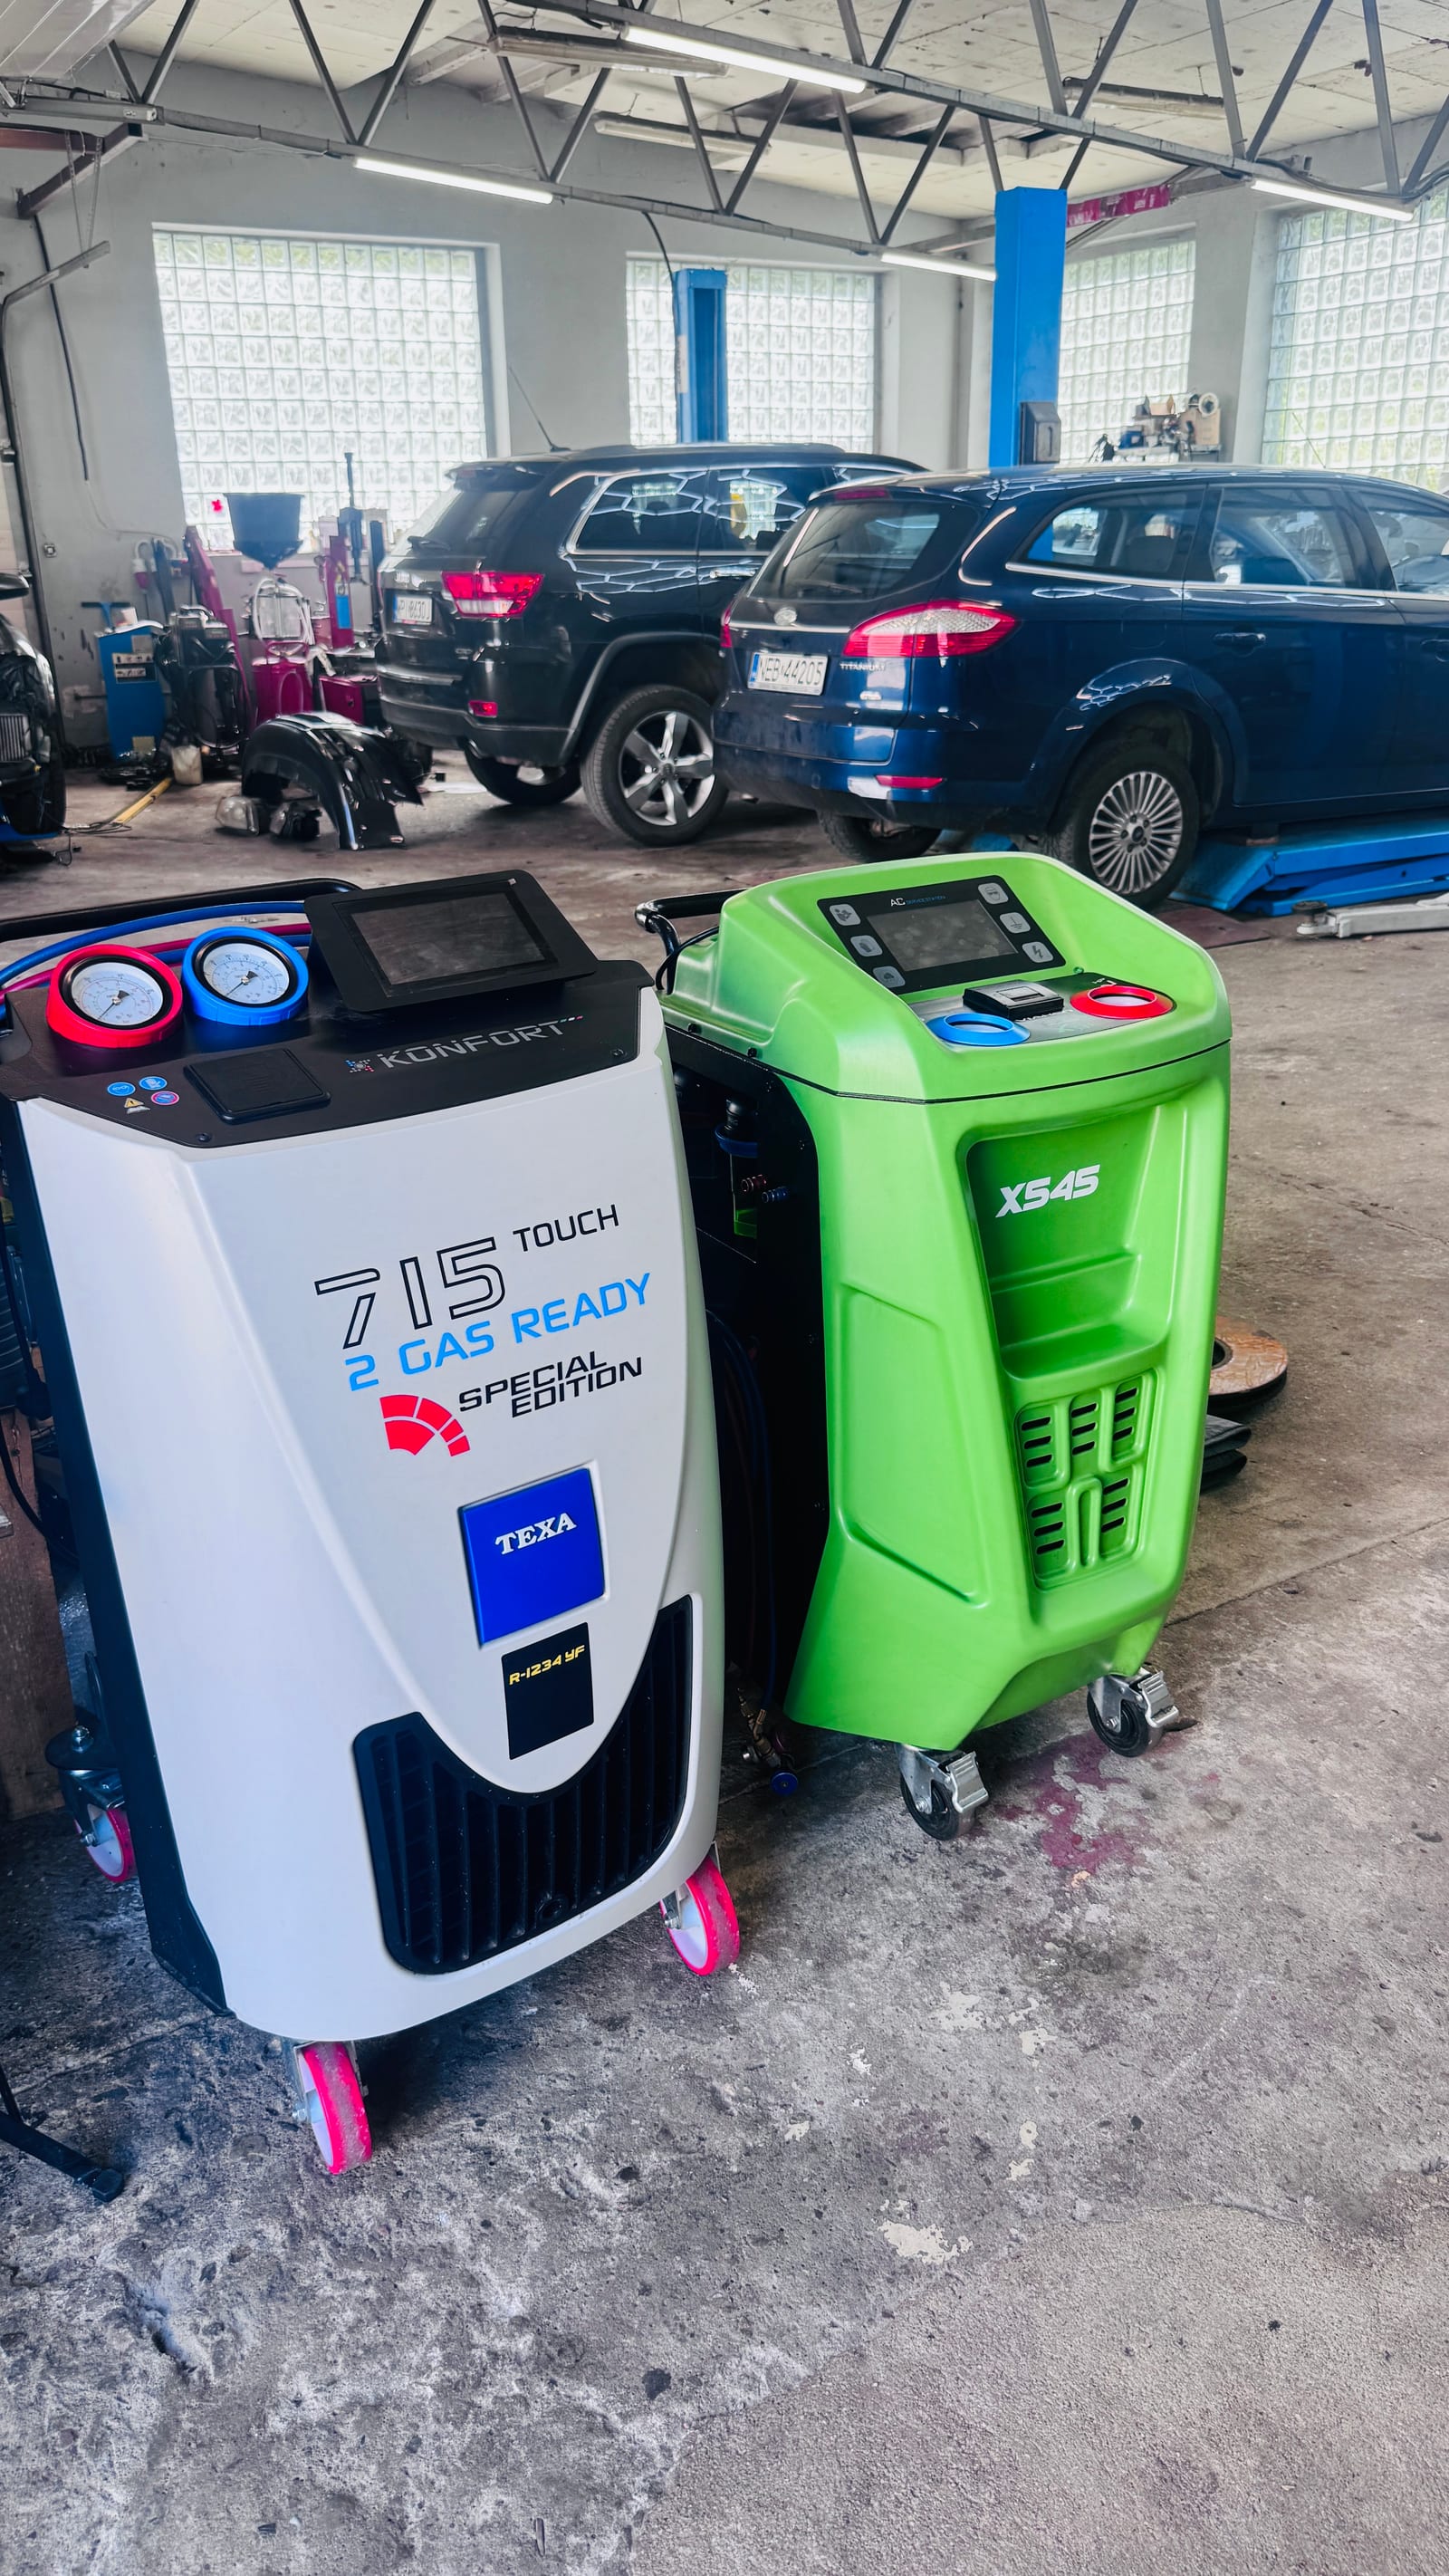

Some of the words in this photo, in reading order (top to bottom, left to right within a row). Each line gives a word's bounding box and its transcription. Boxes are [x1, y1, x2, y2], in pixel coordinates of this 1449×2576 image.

[783, 658, 823, 686] 44205
[890, 897, 906, 907] AC
[377, 1020, 563, 1069] KONFORT
[994, 1163, 1101, 1219] X545
[313, 1235, 507, 1350] 715
[512, 1204, 619, 1252] TOUCH
[344, 1353, 380, 1392] 2
[398, 1320, 496, 1376] GAS
[511, 1272, 651, 1344] READY
[458, 1350, 609, 1412] SPECIAL
[511, 1356, 643, 1418] EDITION
[494, 1512, 578, 1556] TEXA
[508, 1654, 562, 1686] R-1234
